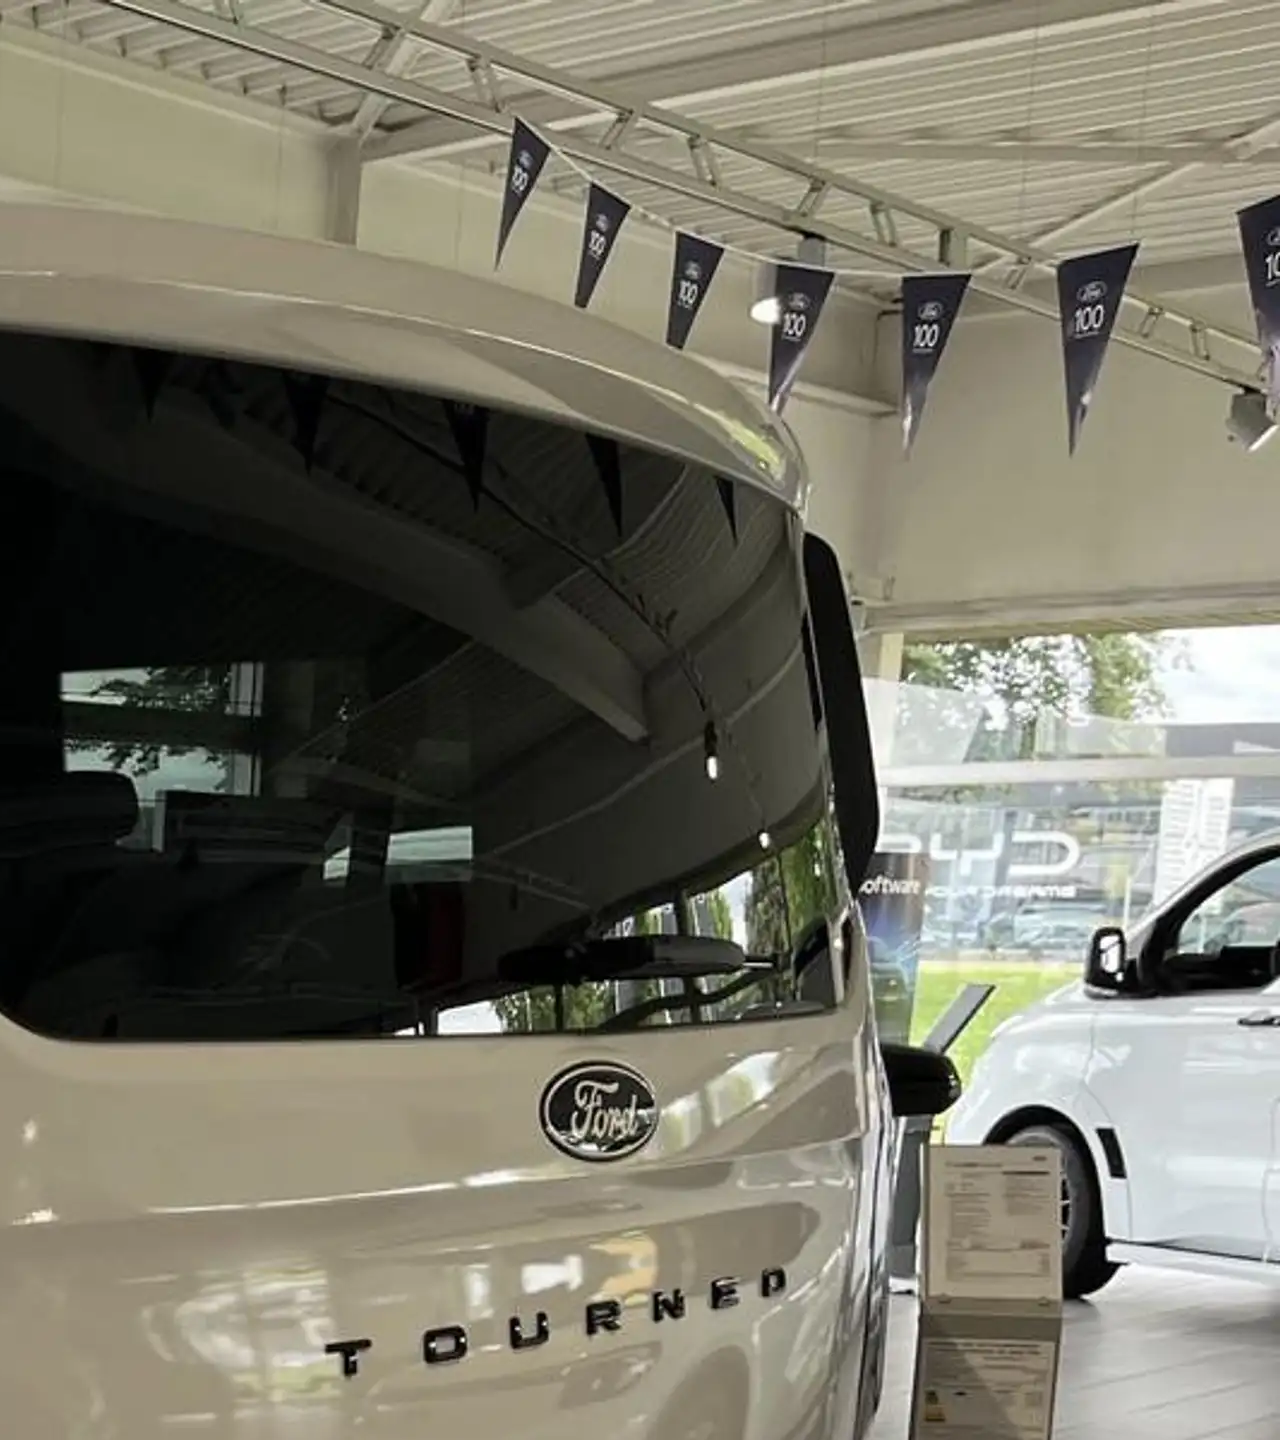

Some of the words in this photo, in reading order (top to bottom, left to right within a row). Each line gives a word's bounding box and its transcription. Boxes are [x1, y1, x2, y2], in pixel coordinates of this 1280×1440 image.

[678, 279, 699, 305] 100
[782, 312, 807, 338] 100
[1074, 303, 1104, 333] 100
[912, 323, 940, 348] 100
[570, 1079, 638, 1142] Ford
